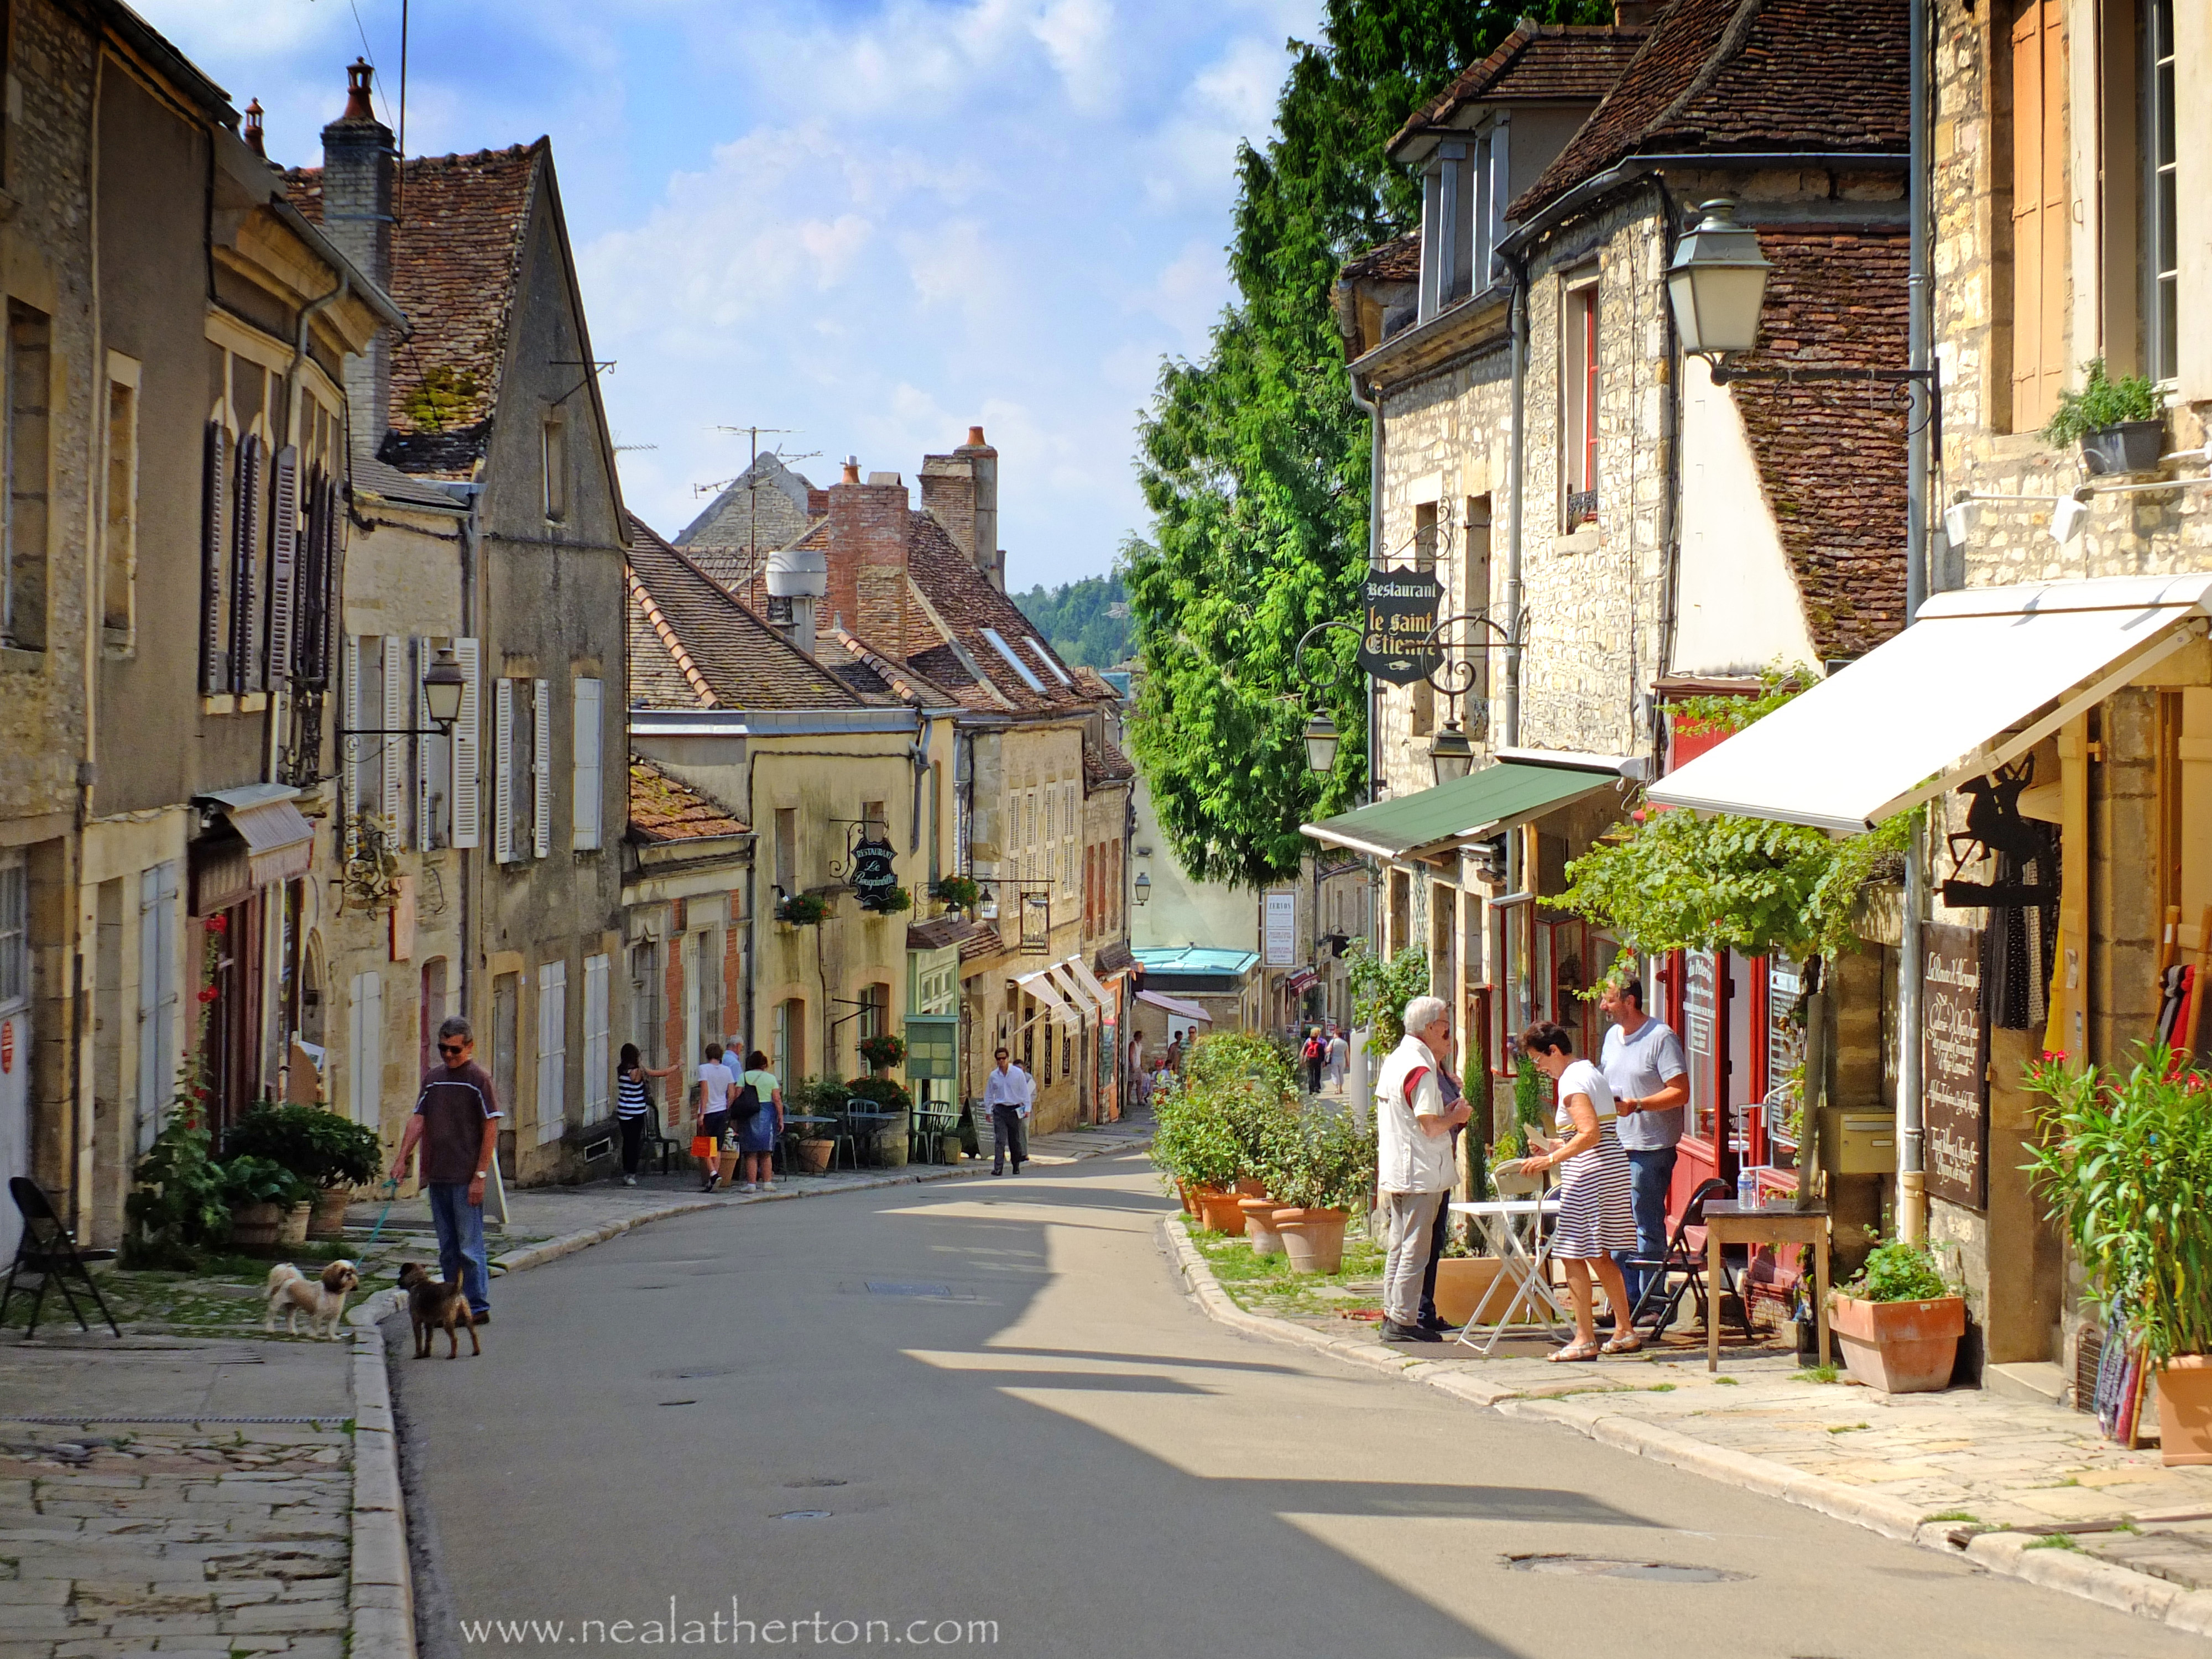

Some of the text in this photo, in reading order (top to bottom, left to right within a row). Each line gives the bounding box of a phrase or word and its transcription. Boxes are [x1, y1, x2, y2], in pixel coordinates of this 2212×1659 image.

[1366, 581, 1437, 601] Restaurant
[856, 848, 894, 860] RESTAURANT
[864, 860, 880, 872] Le
